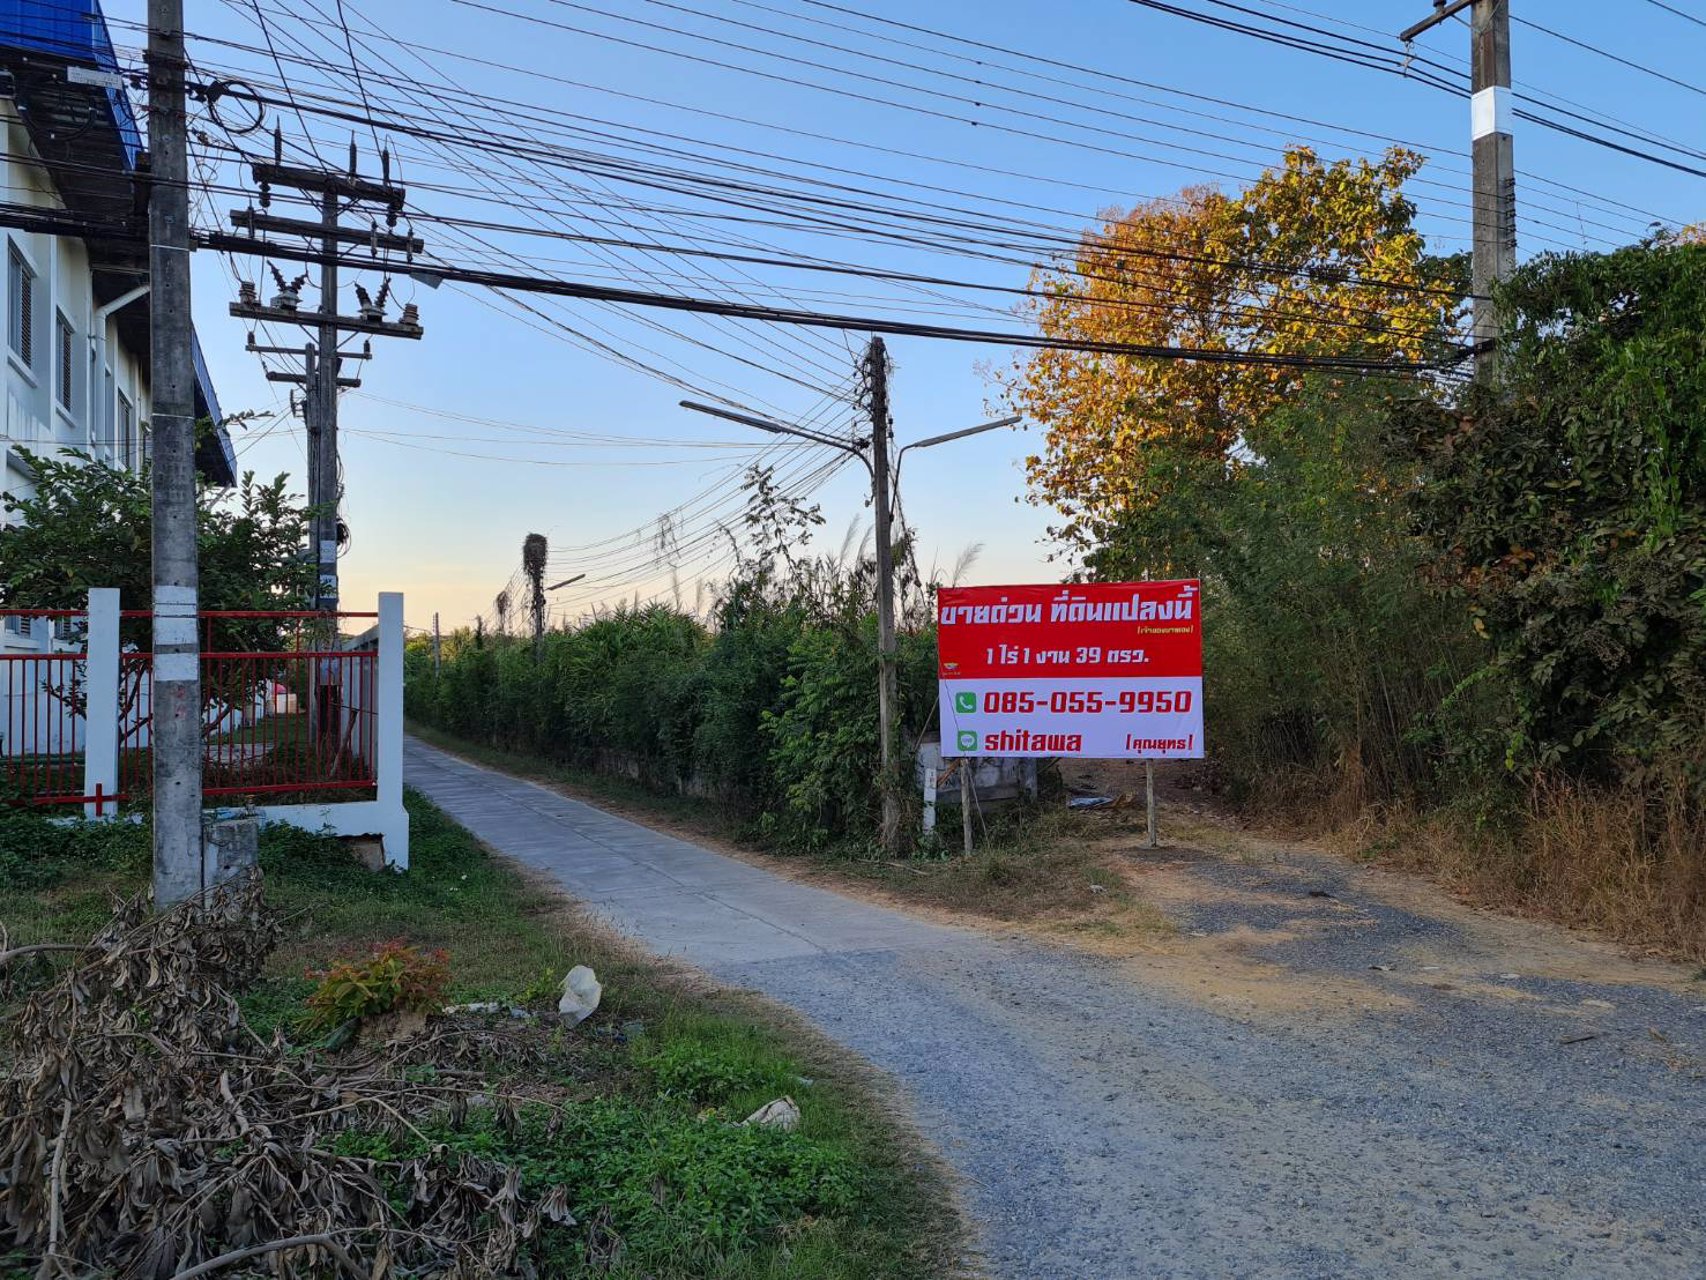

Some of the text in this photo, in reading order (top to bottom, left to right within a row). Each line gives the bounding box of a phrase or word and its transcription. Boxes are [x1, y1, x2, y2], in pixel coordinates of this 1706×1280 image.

[940, 585, 1198, 625] ขายด่วน ที่ดินแปลงนี้
[986, 644, 1149, 665] 1 ไร่ 1 งาน 39 ตรว.
[983, 690, 1192, 714] 085-055-9950
[984, 728, 1082, 752] shitawa
